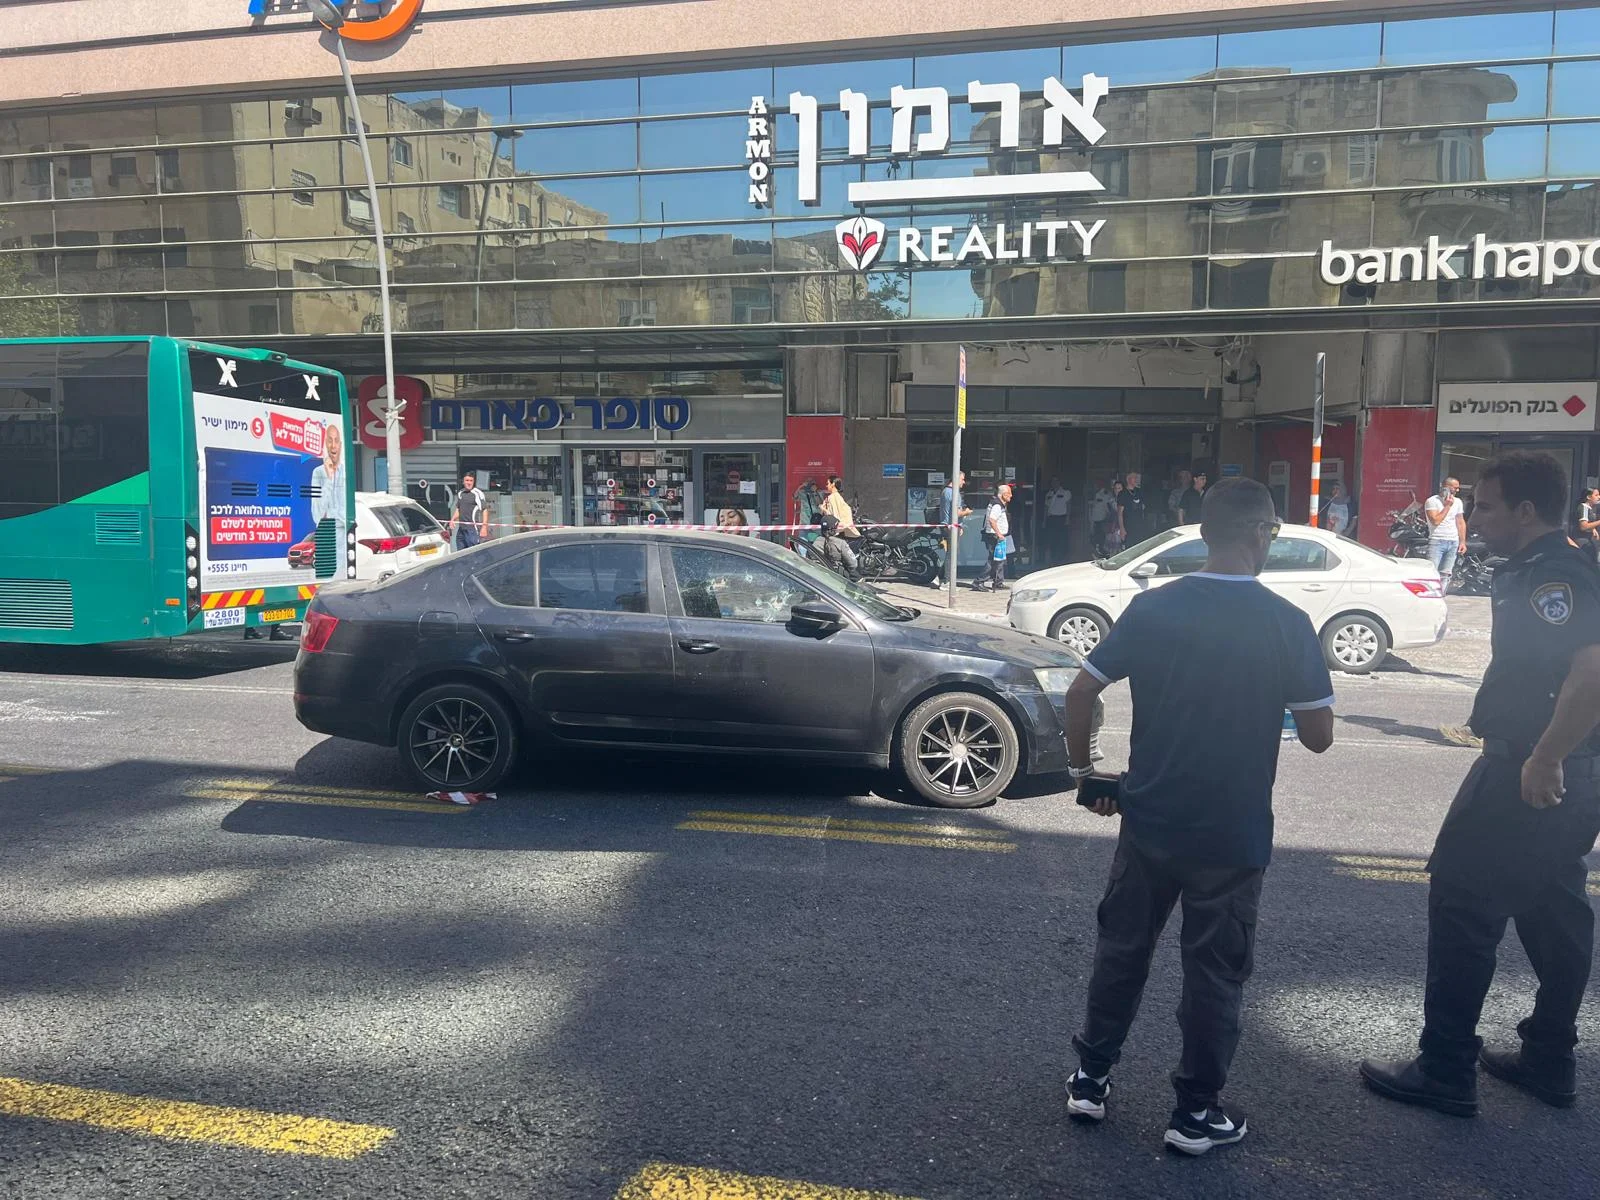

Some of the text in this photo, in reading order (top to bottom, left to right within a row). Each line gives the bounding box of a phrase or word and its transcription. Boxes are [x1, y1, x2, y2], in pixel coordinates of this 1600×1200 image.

[789, 72, 1109, 202] ארמון
[745, 95, 771, 205] ARMON
[899, 219, 1107, 263] REALITY
[1320, 235, 1460, 285] bank
[1449, 398, 1559, 416] בנק הפועלים
[201, 416, 248, 431] מימון ישיר
[275, 428, 303, 445] עוד לא
[211, 503, 291, 517] לוקחים הלוואה לרכב
[221, 517, 283, 529] ומתחילים לשלם
[216, 531, 288, 543] רק בעוד 3 חודשים
[231, 563, 248, 572] חייגו
